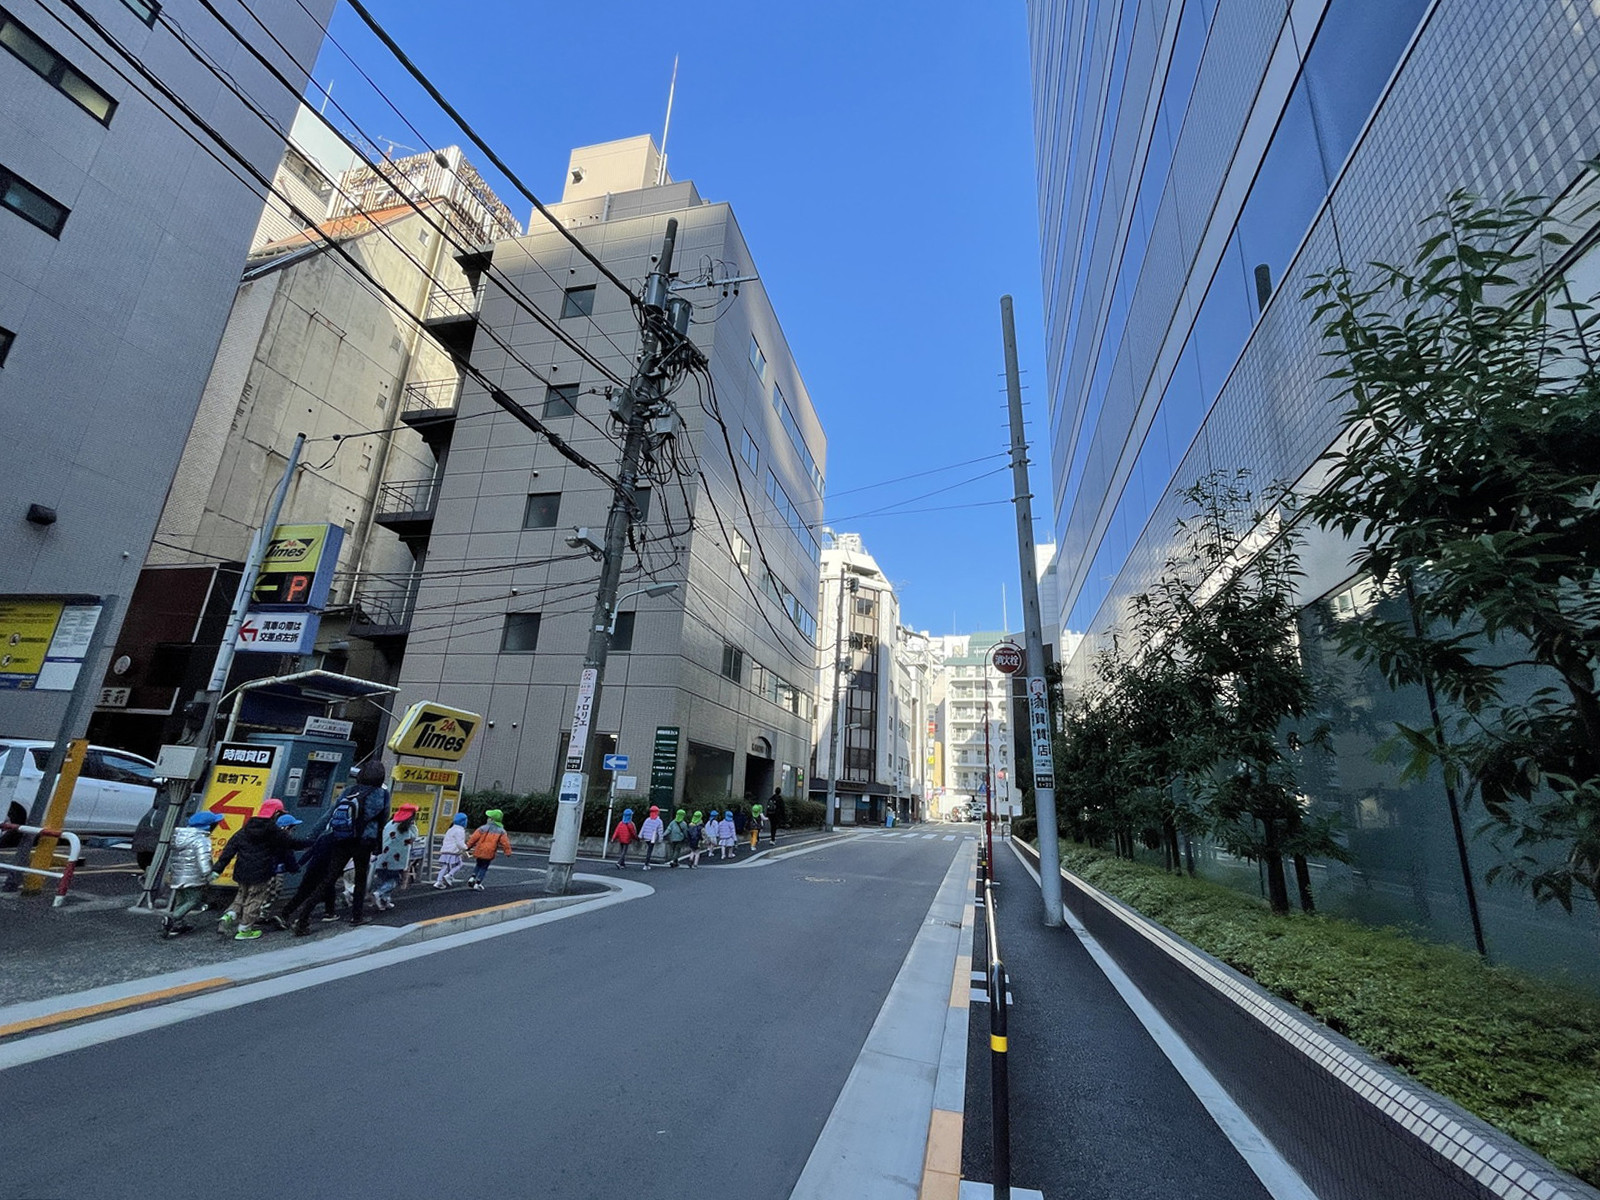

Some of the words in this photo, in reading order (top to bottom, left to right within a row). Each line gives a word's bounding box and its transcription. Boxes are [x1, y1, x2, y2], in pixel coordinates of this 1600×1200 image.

[287, 575, 308, 602] P
[995, 655, 1019, 667] 消火栓
[413, 723, 466, 753] Times
